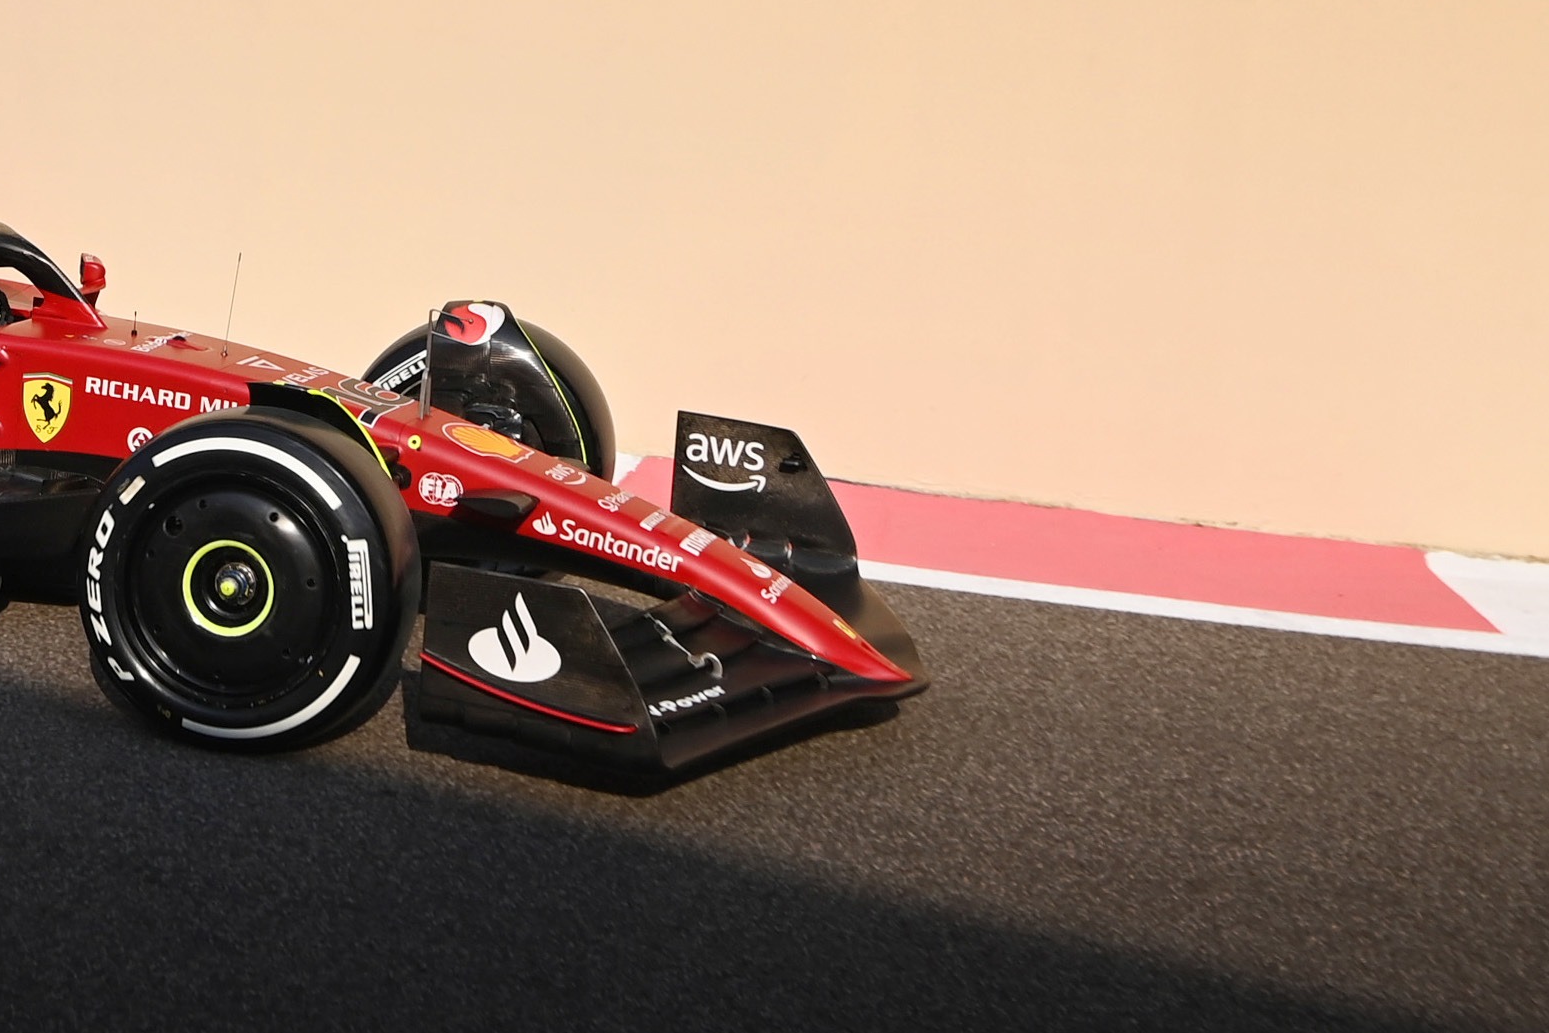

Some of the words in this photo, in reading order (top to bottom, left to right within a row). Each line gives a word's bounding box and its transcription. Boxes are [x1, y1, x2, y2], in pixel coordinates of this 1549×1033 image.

[84, 375, 191, 410] RICHARD
[685, 432, 765, 472] aws
[559, 519, 684, 573] Santander
[85, 508, 116, 647] ZERO
[341, 534, 374, 630] PIRELLI
